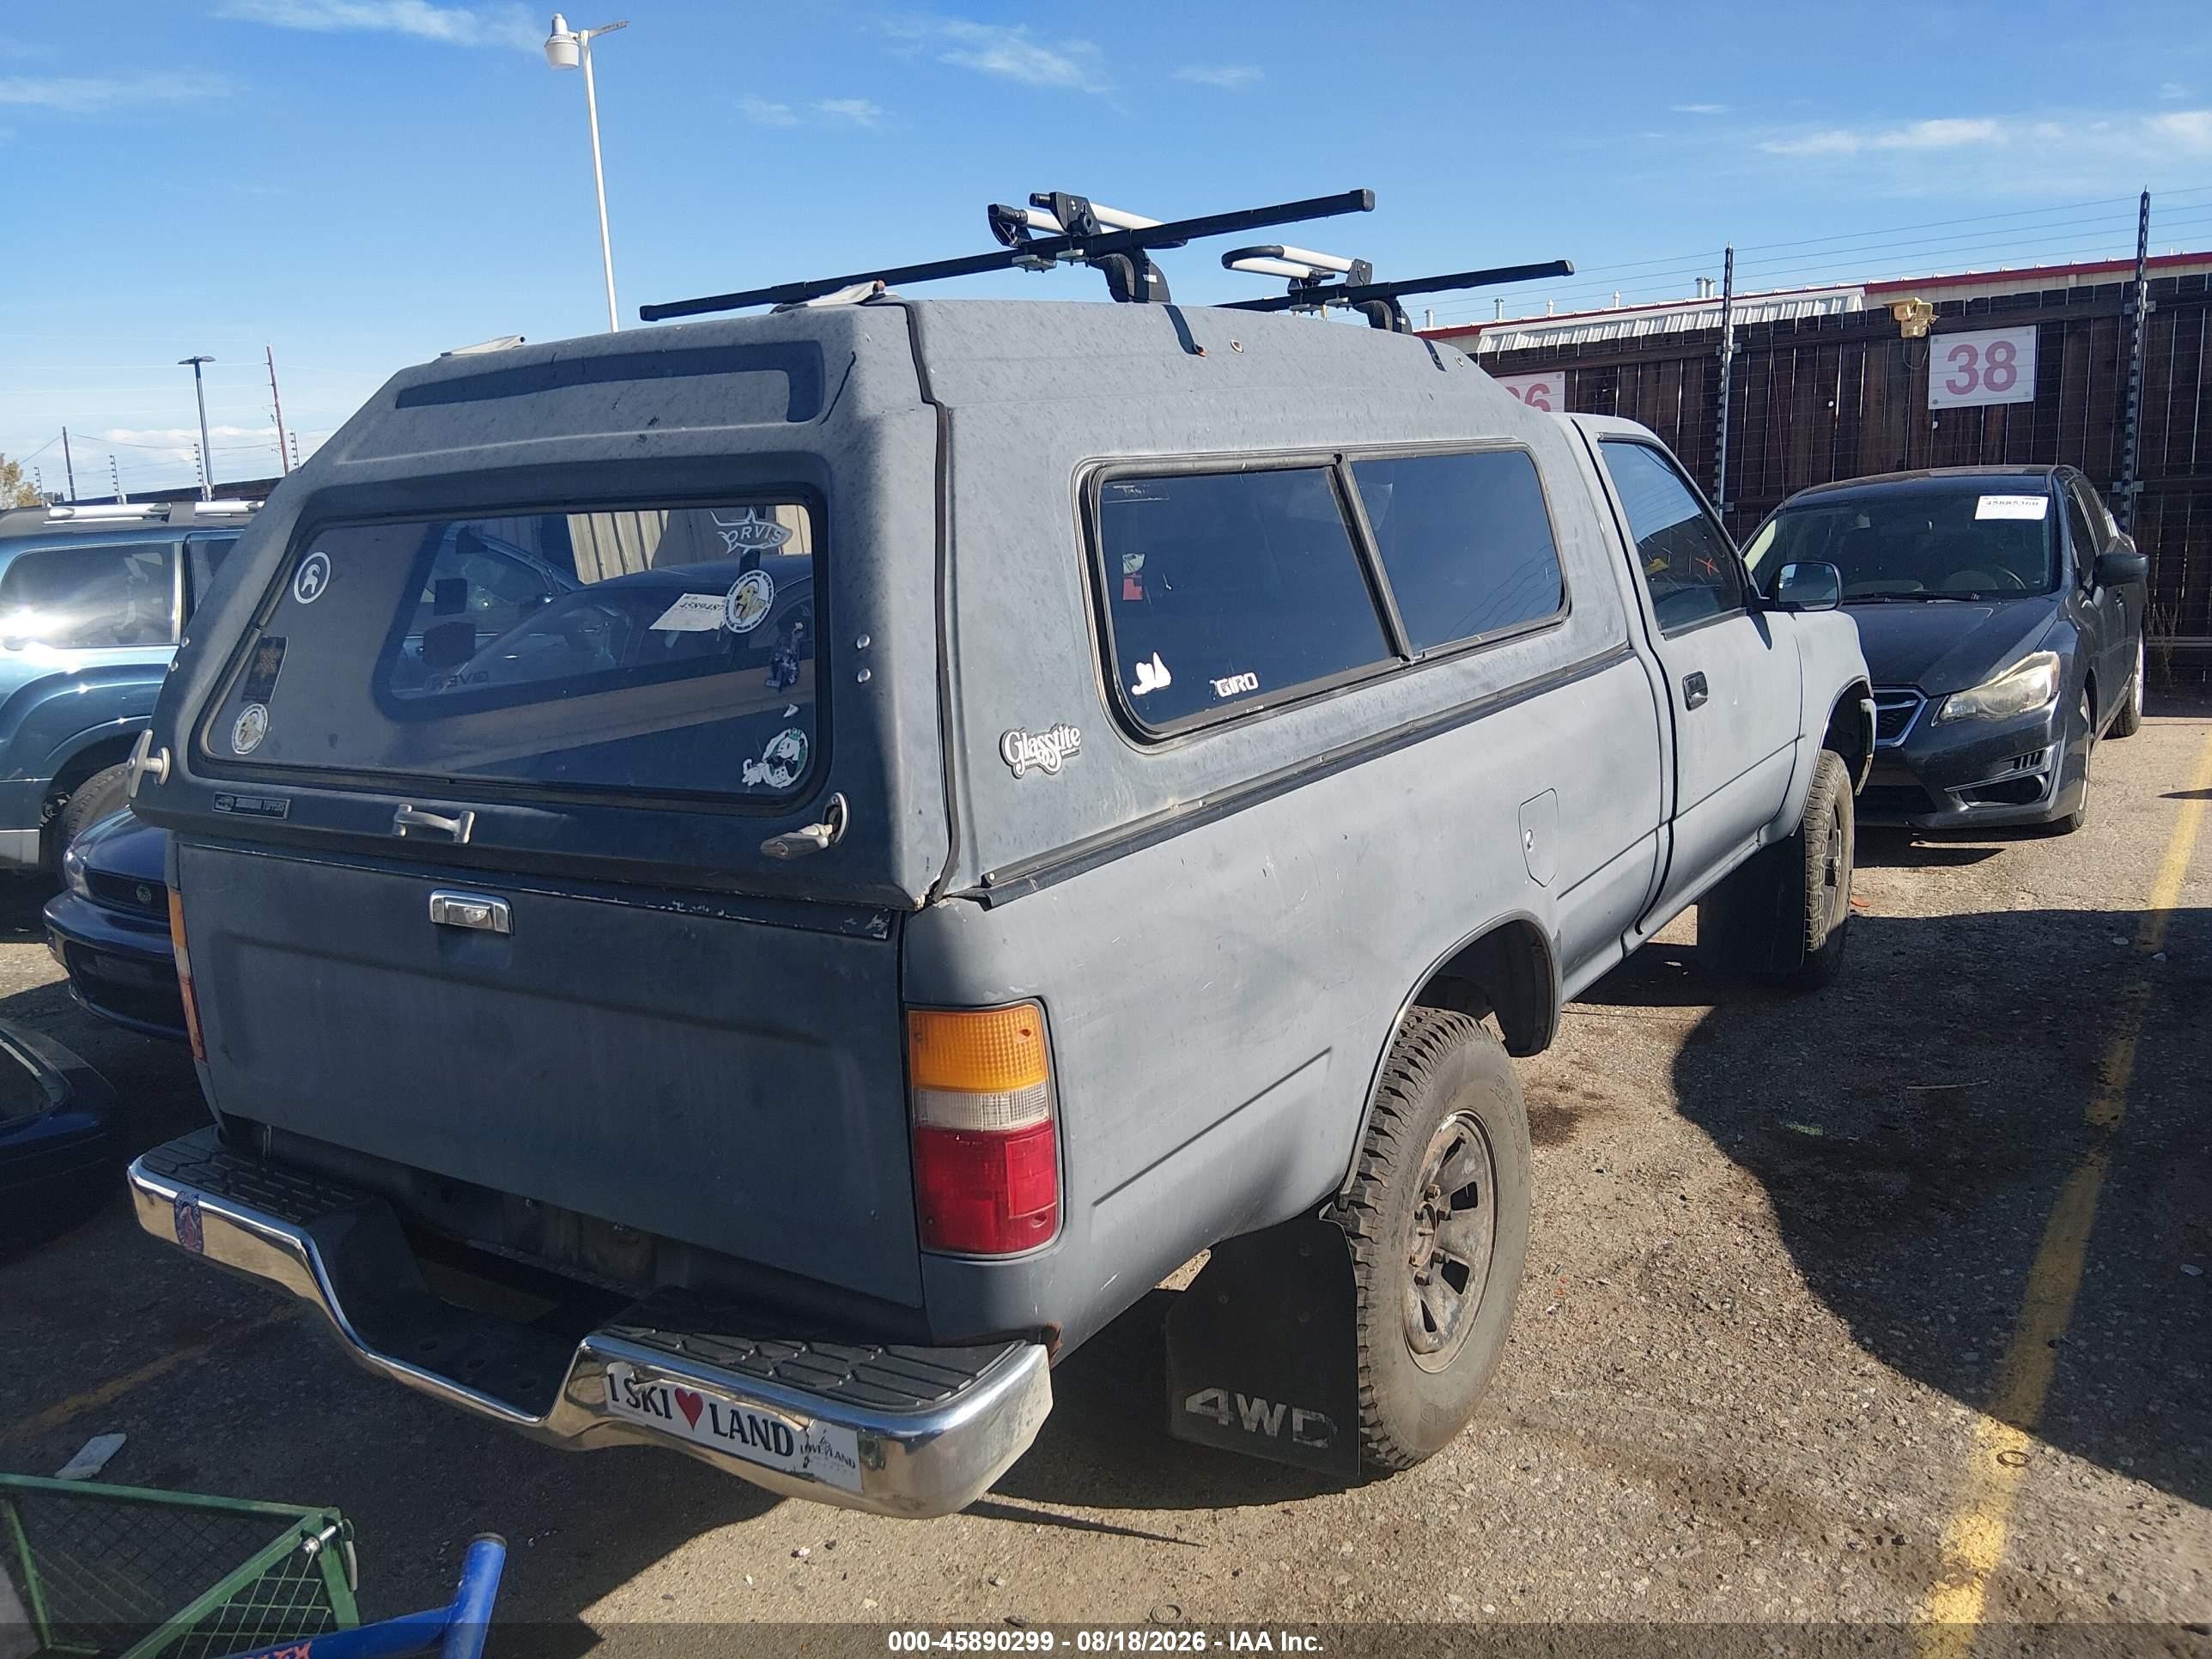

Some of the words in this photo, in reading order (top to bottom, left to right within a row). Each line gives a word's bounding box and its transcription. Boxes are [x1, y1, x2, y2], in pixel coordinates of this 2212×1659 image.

[1946, 341, 2017, 395] 38
[727, 524, 783, 545] ORVIS
[1216, 672, 1259, 697] GIRO
[606, 1373, 619, 1402] I
[623, 1376, 672, 1420] SKI
[708, 1401, 794, 1457] LAND
[1185, 1387, 1340, 1449] 4WD
